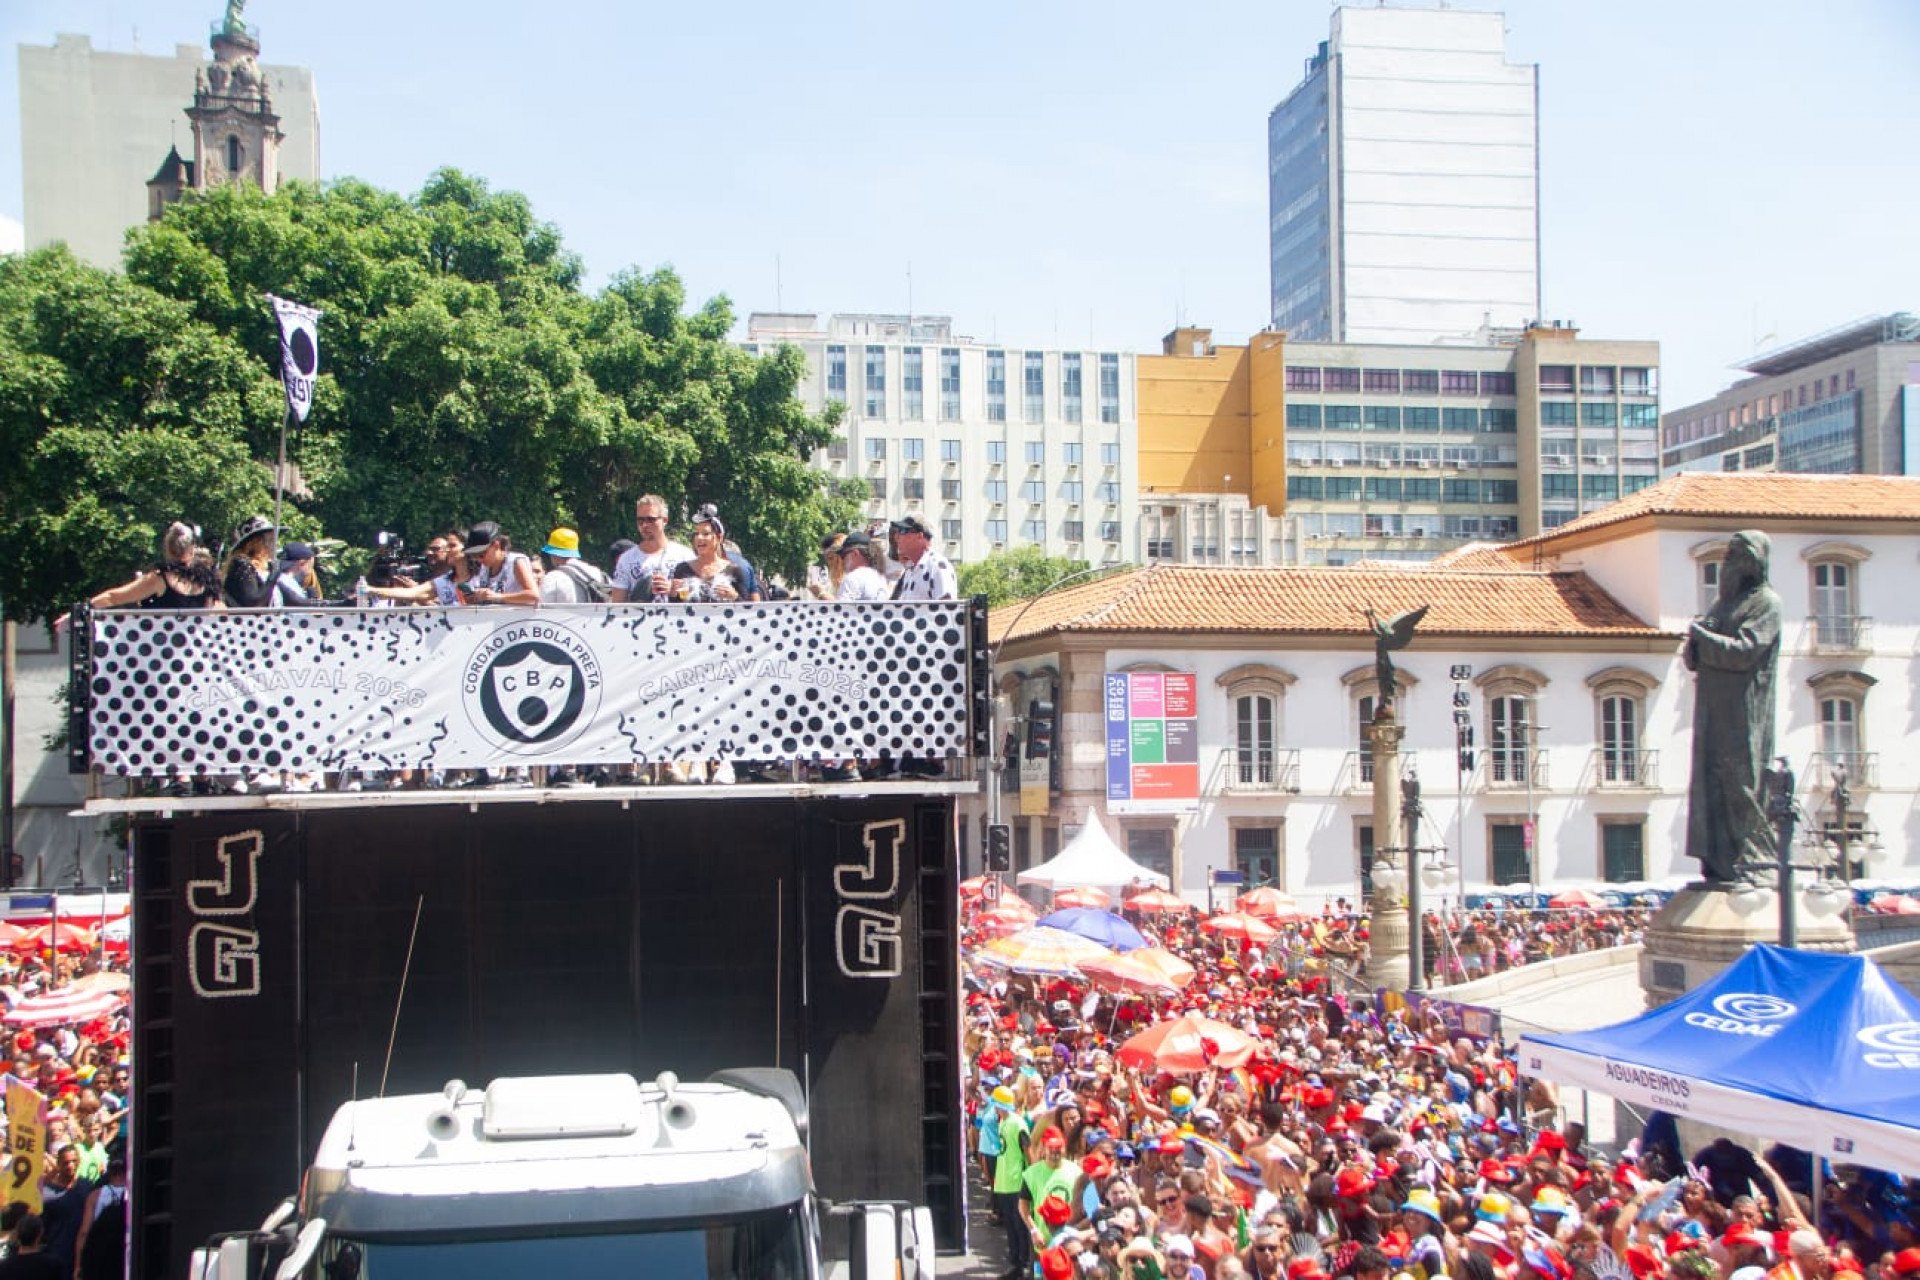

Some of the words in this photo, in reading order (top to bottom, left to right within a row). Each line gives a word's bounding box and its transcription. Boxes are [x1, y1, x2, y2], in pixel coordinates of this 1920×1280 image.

[507, 628, 528, 642] DA
[532, 626, 571, 647] BOLA
[572, 644, 600, 690] PRETA
[185, 669, 347, 712] CARNAVAL
[355, 672, 427, 709] 2026
[639, 659, 791, 701] CARNAVAL
[799, 663, 868, 699] 2026
[1684, 1012, 1783, 1037] CEDAE
[1605, 1062, 1690, 1097] AGUADEIROS
[12, 1156, 32, 1188] 9
